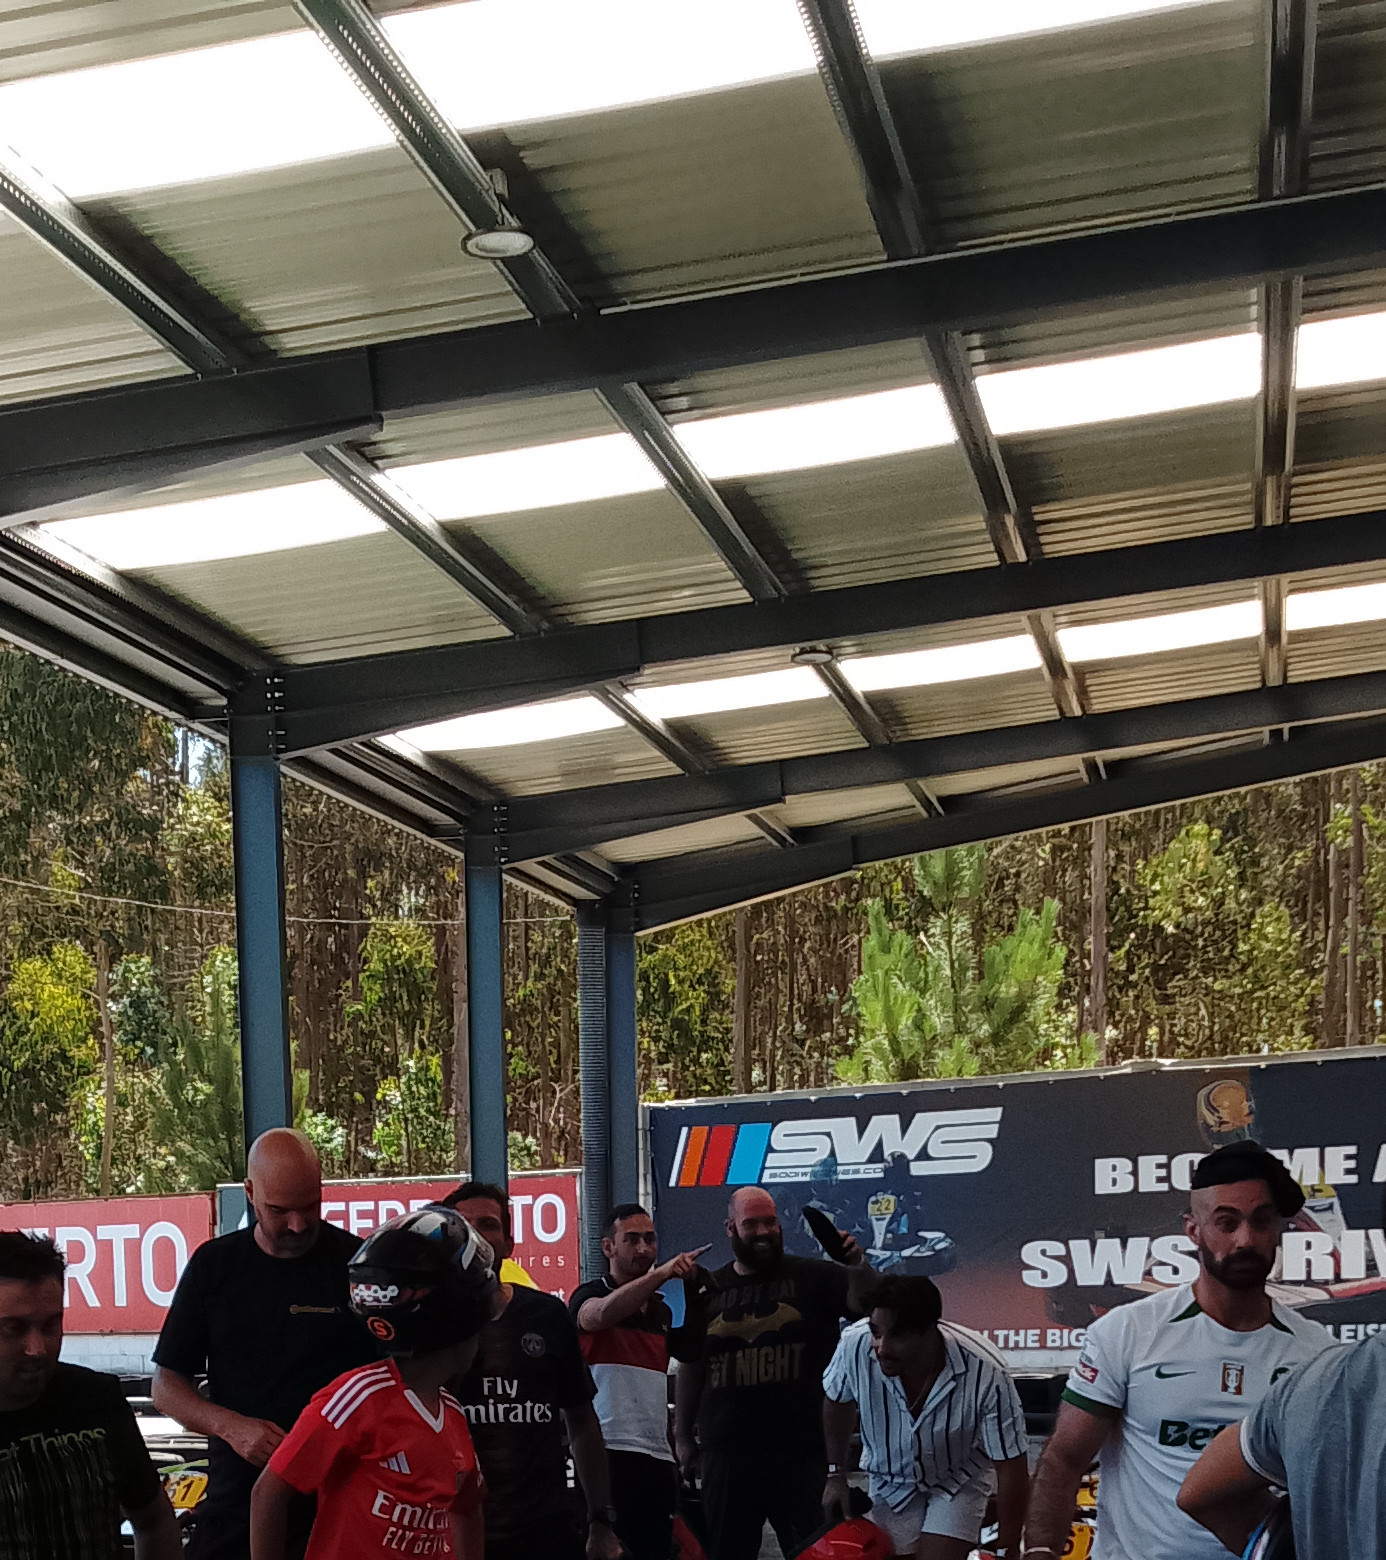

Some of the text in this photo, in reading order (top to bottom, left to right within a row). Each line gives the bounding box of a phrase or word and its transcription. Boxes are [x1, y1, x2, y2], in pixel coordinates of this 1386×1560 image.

[764, 1107, 1004, 1176] SWS
[1094, 1143, 1360, 1196] BECME
[875, 1200, 893, 1214] 22
[1020, 1234, 1201, 1290] SWS
[993, 1328, 1041, 1348] THE
[735, 1342, 807, 1388] NIGHT
[482, 1376, 519, 1399] Fly
[381, 1525, 415, 1552] FLY
